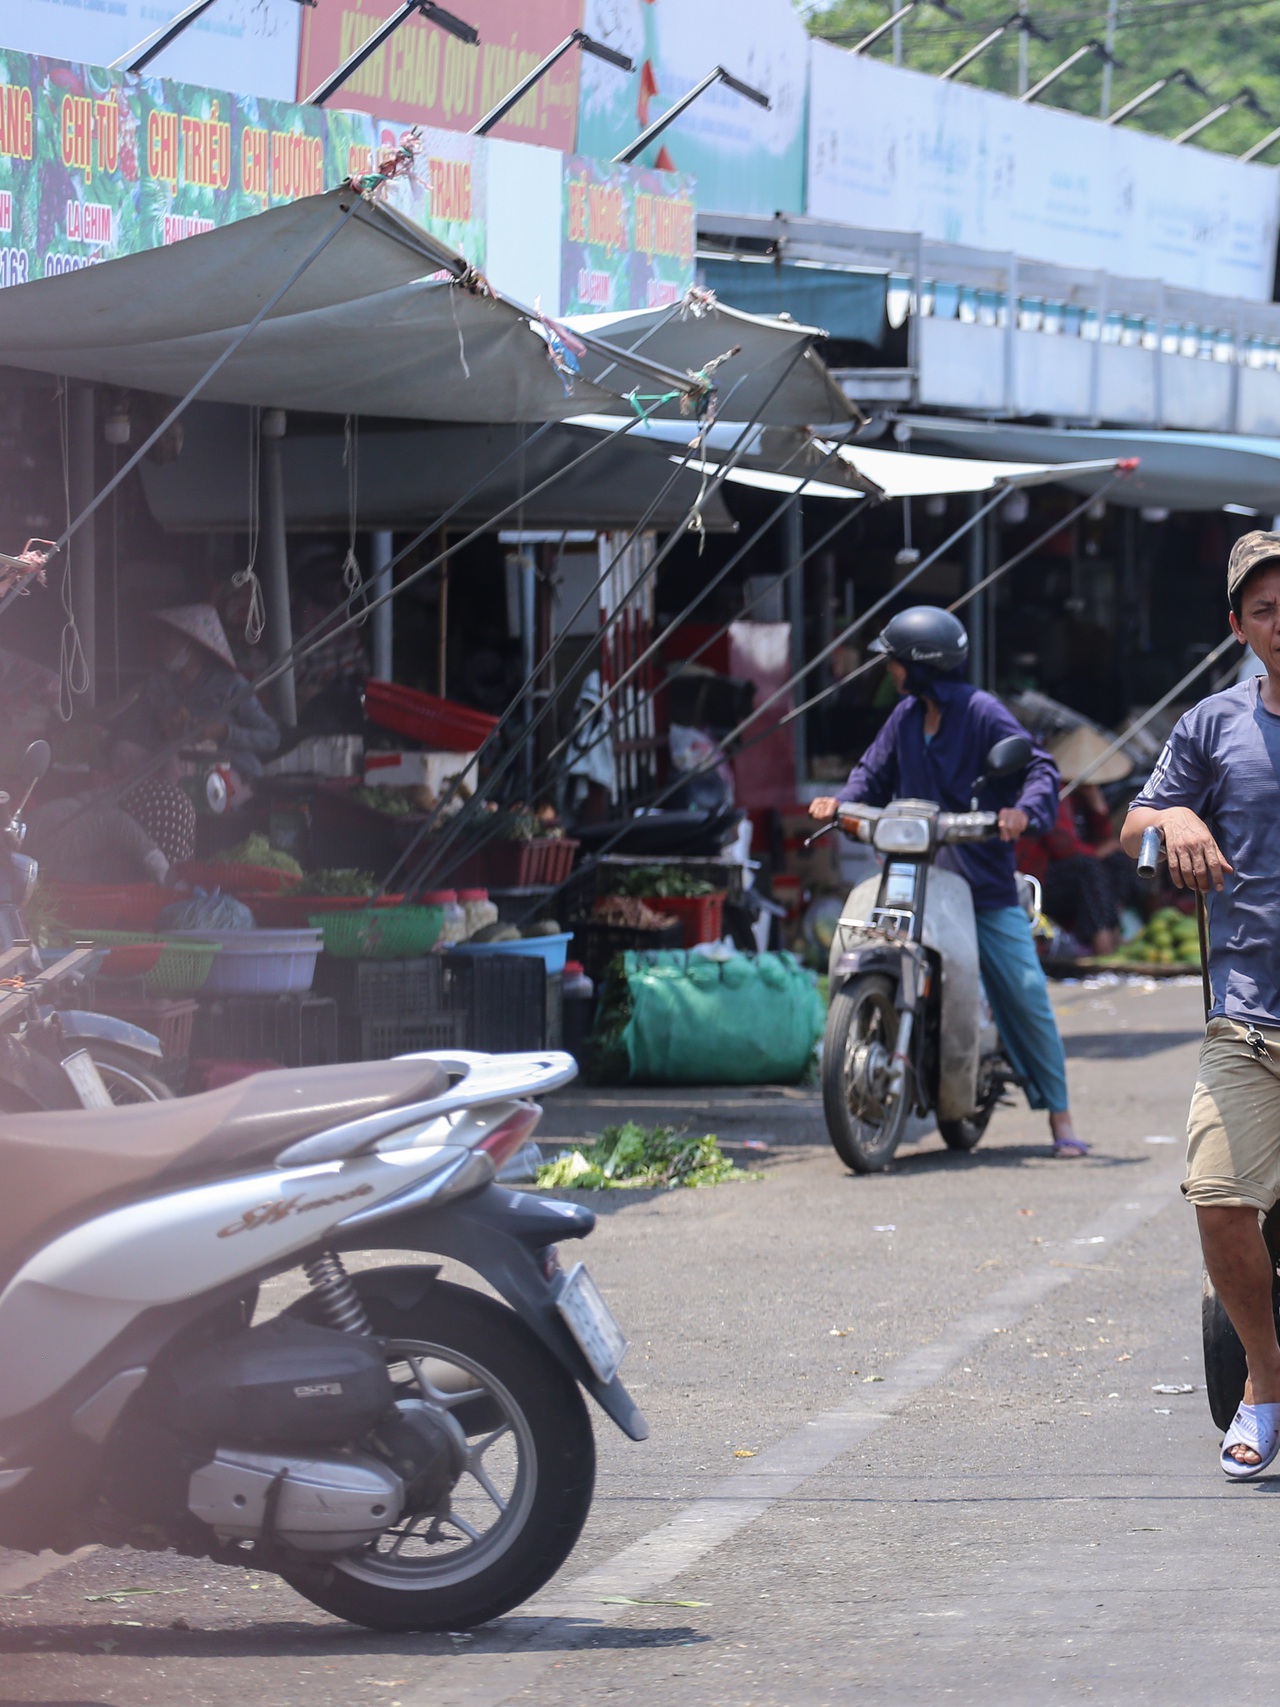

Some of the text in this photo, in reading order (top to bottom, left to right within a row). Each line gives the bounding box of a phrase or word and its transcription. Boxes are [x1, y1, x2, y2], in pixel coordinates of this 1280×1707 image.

[61, 88, 119, 184] CHỊ TÚ
[148, 109, 178, 197] CHỊ
[241, 125, 269, 209] CHỊ
[67, 200, 113, 244] LA GHIM
